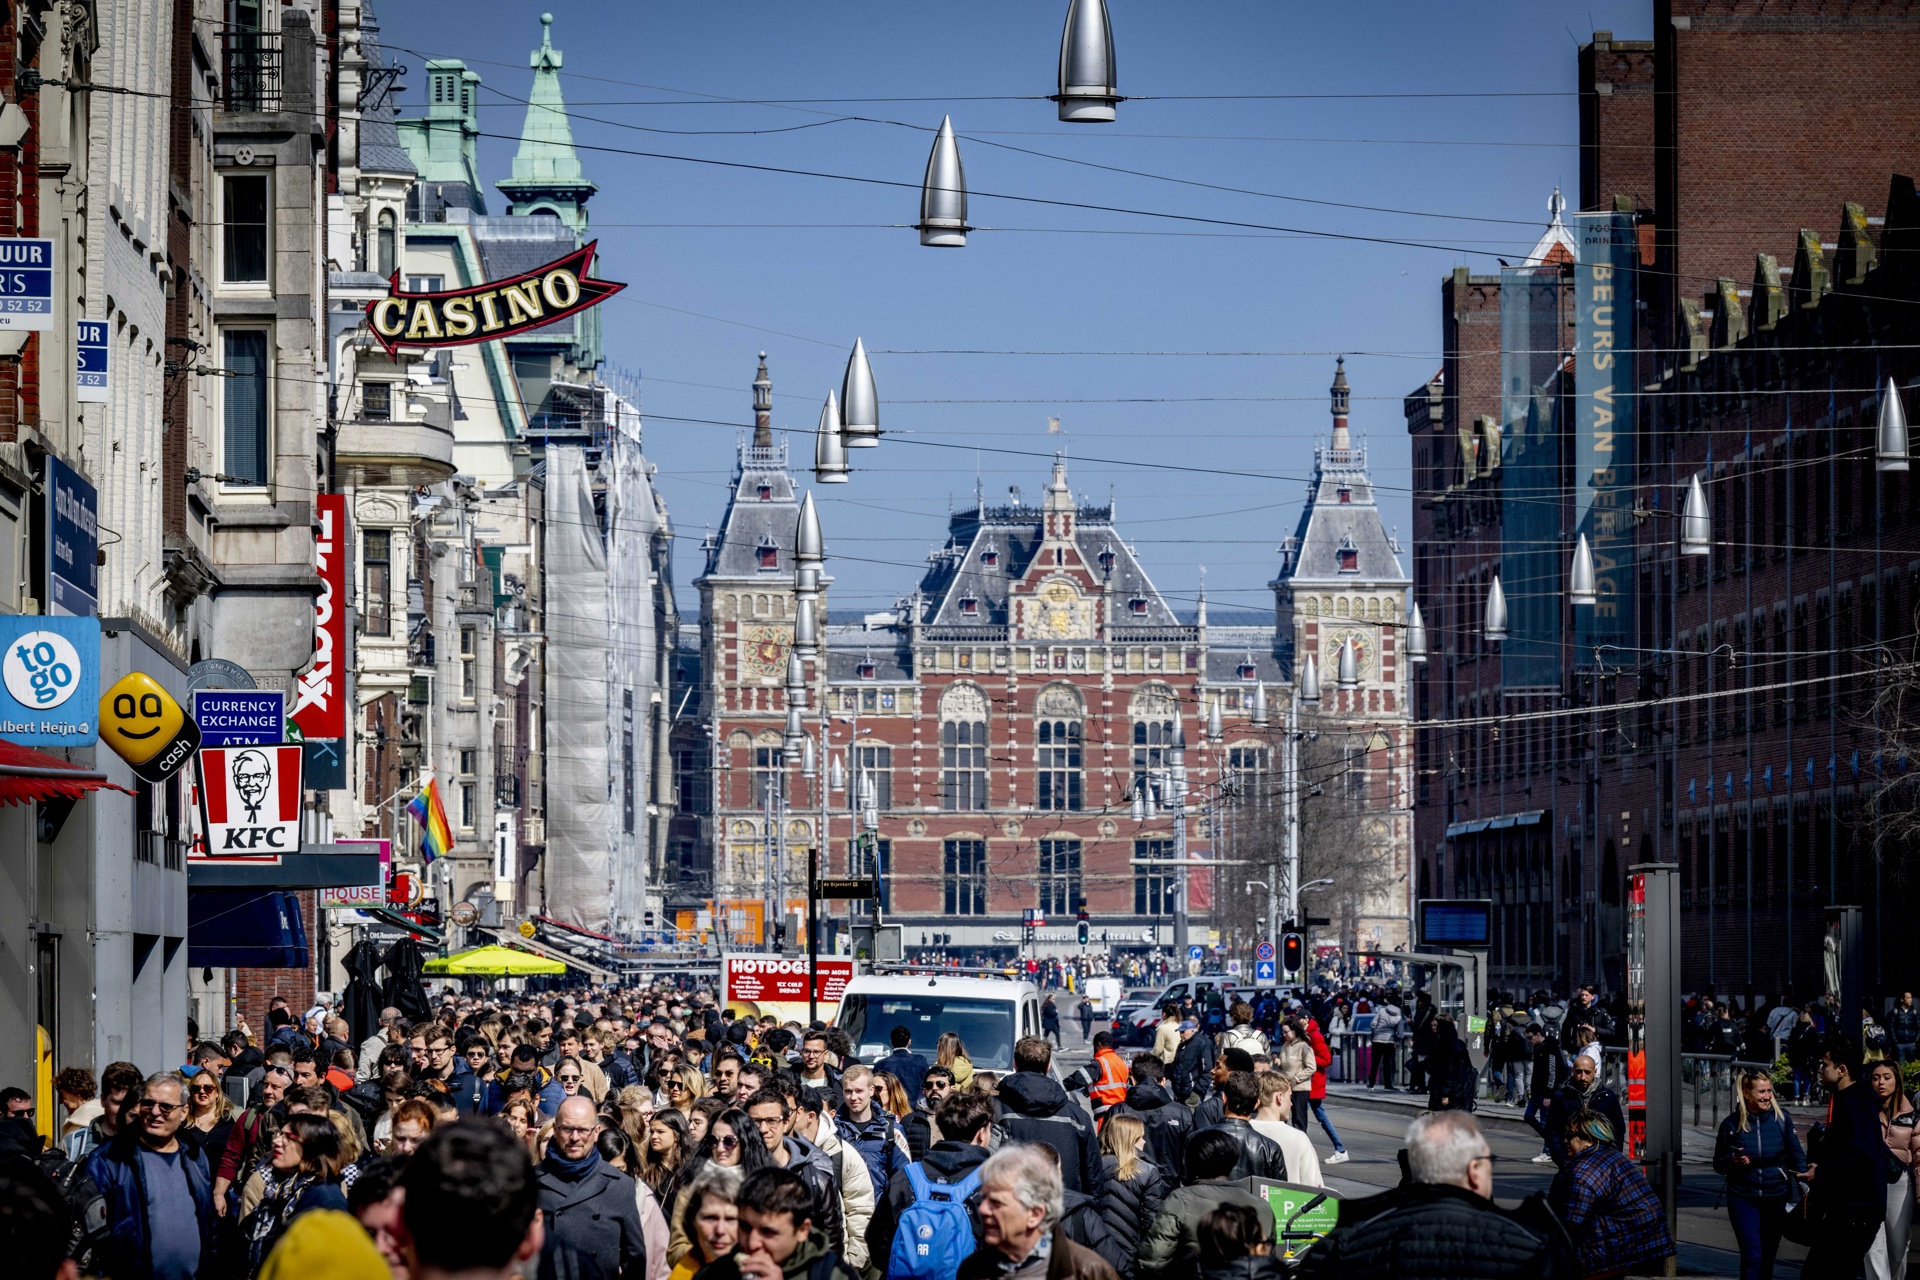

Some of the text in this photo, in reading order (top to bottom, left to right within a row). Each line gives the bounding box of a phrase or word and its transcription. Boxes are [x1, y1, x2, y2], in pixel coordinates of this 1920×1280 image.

[1585, 237, 1623, 245] DRINKS
[7, 301, 43, 312] 52 52
[373, 268, 581, 339] CASINO
[87, 376, 100, 385] 52
[1592, 263, 1617, 618] BEURS VAN BERLAGE
[1586, 635, 1625, 643] EVENTS
[16, 641, 56, 672] to
[30, 662, 73, 704] go
[202, 701, 277, 712] CURRENCY
[201, 716, 277, 727] EXCHANGE
[40, 721, 76, 736] Heijn
[222, 737, 260, 745] ATM
[159, 739, 192, 771] cash
[222, 827, 286, 850] KFC
[324, 887, 381, 900] HOUSE
[1033, 909, 1043, 920] M
[1089, 931, 1135, 941] Cetraal
[731, 960, 810, 975] HOTDOGS
[1284, 1201, 1295, 1215] P
